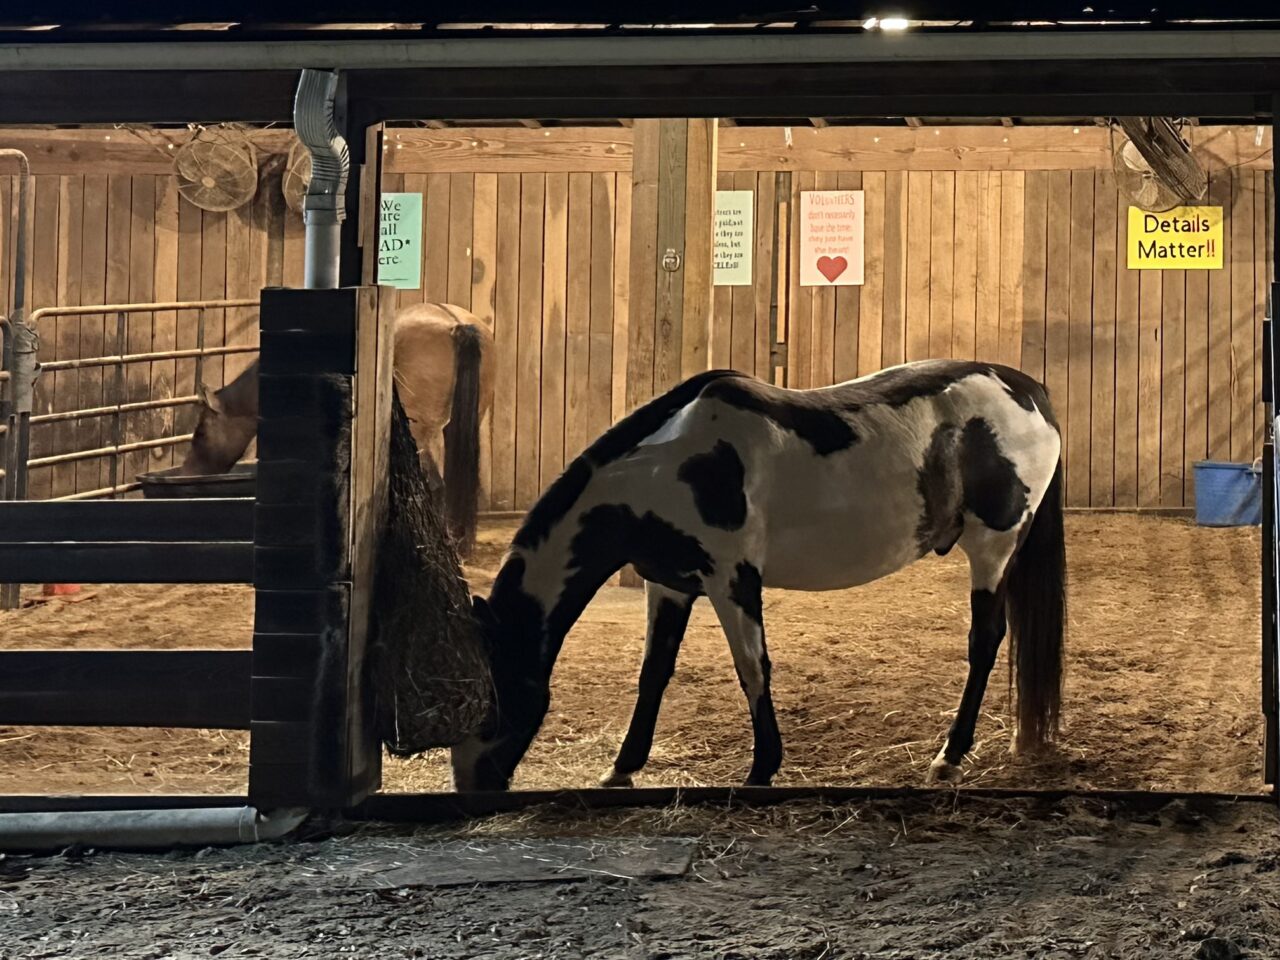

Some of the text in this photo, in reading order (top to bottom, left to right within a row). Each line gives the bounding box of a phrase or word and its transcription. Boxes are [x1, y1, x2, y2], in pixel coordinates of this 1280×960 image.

[381, 200, 401, 211] We
[809, 193, 855, 206] VOLUNTEERS
[381, 223, 397, 235] all
[1144, 213, 1210, 233] Details
[379, 238, 411, 252] AD
[1138, 239, 1215, 259] Matter!!
[378, 255, 402, 265] ere.
